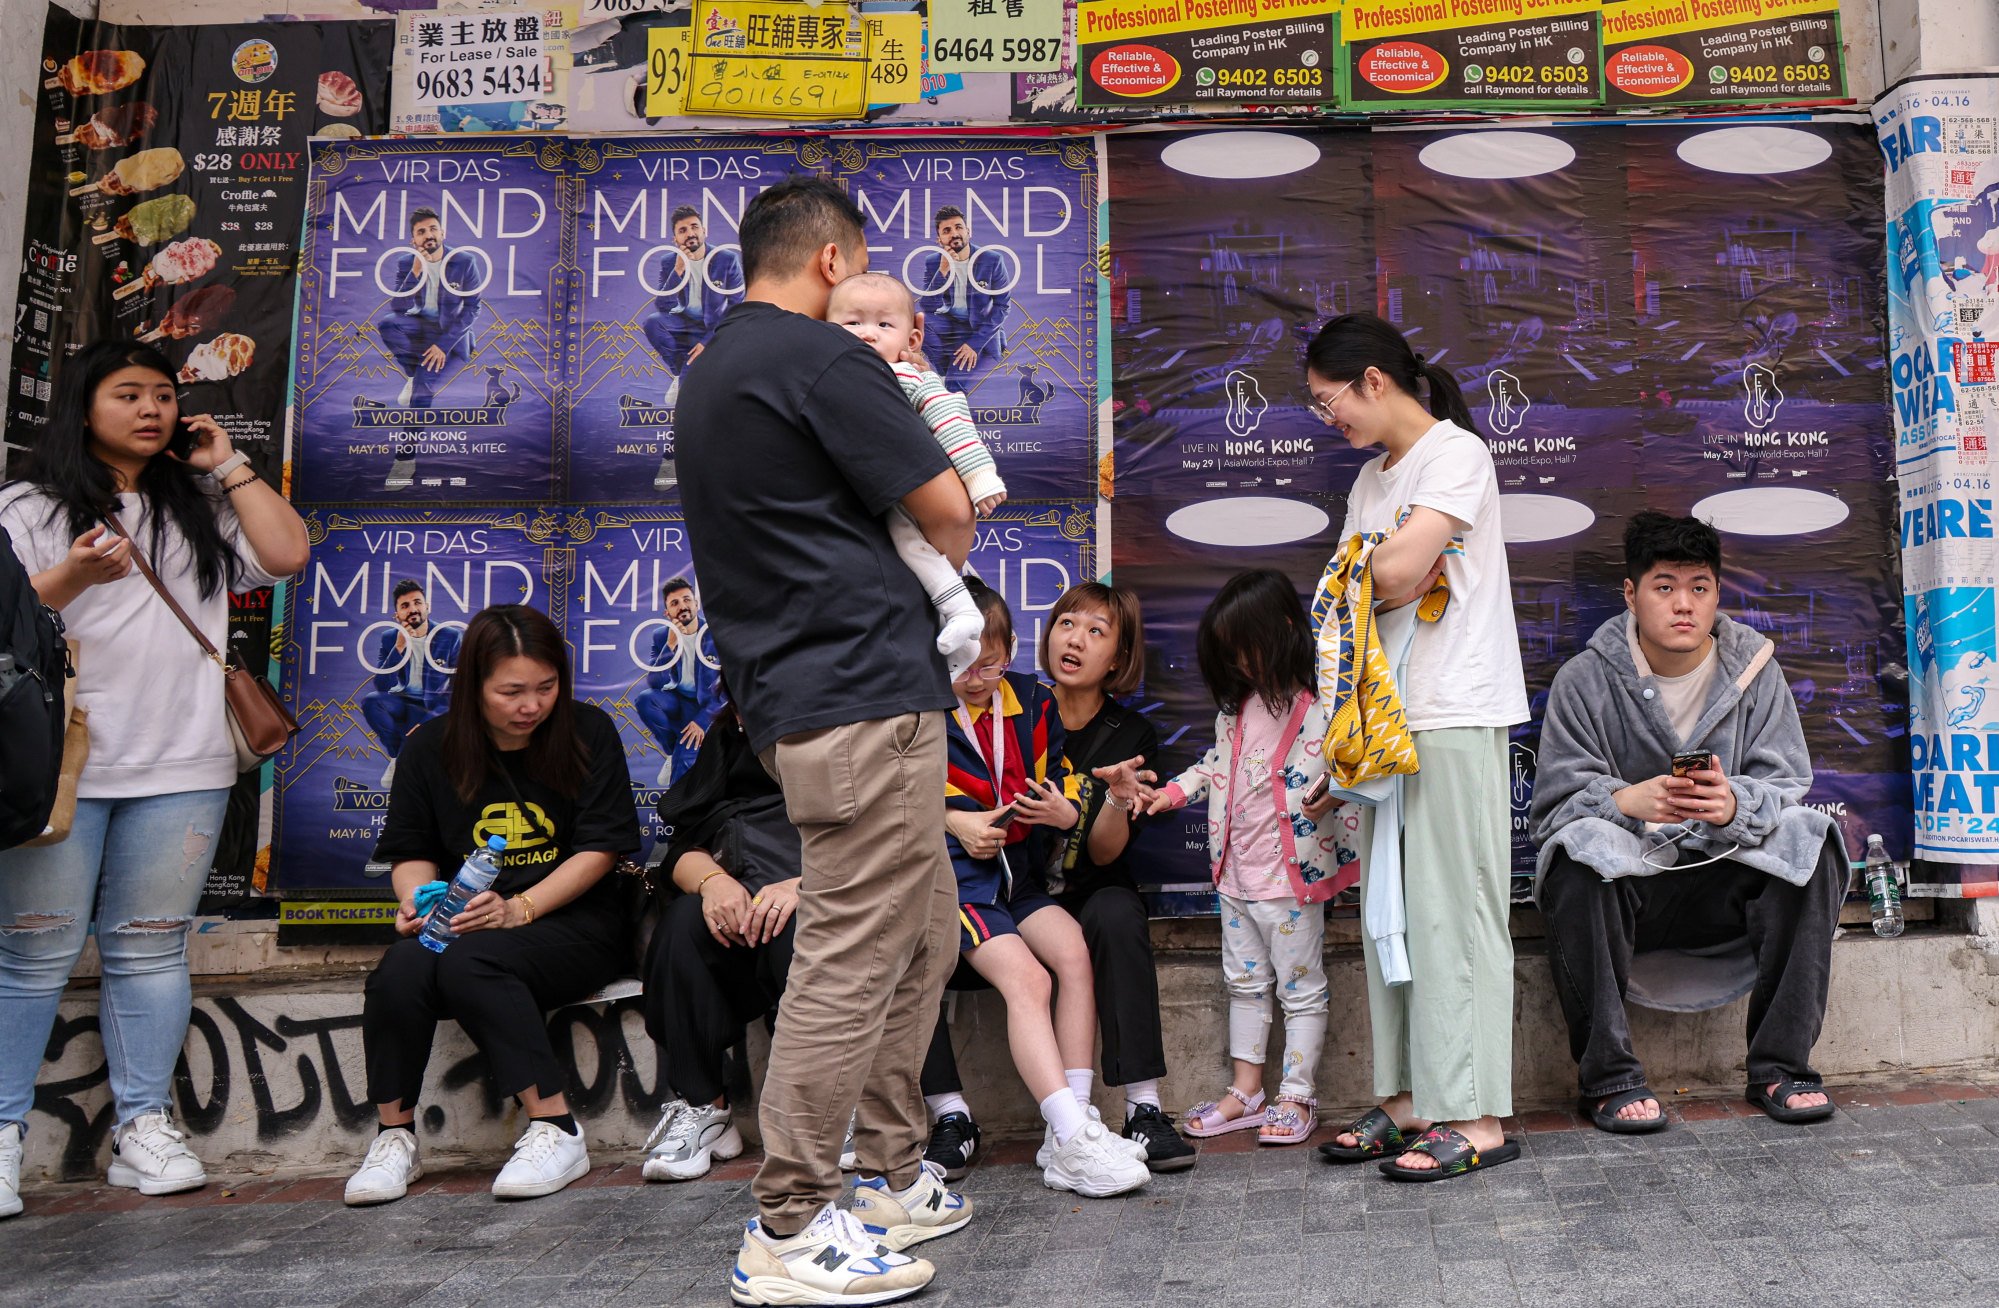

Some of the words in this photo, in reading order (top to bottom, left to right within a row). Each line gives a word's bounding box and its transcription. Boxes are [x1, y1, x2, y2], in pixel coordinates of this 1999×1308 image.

[1087, 0, 1181, 32] Professional
[1185, 0, 1258, 20] Postering
[1354, 0, 1447, 30] Professional
[1452, 0, 1523, 18] Postering
[1691, 0, 1762, 20] Postering
[418, 15, 540, 48] 業主放盤
[747, 14, 846, 50] 旺舖專家
[1190, 34, 1240, 48] Leading
[1243, 28, 1282, 42] Poster
[1285, 21, 1325, 36] Billing
[1457, 31, 1506, 45] Leading
[1509, 26, 1548, 40] Poster
[1551, 20, 1589, 34] Billing
[1700, 32, 1747, 47] Leading
[1750, 26, 1788, 40] Poster
[1791, 19, 1828, 34] Billing
[420, 52, 446, 64] For
[450, 50, 492, 62] Lease
[506, 46, 538, 58] Sale
[934, 38, 994, 62] 6464
[1002, 38, 1062, 62] 5987
[1192, 44, 1250, 60] Company
[1253, 40, 1265, 52] in
[1268, 38, 1288, 50] HK
[1376, 48, 1423, 59] Reliable,
[1459, 42, 1515, 57] Company
[1519, 38, 1532, 50] in
[1534, 35, 1553, 48] HK
[1703, 42, 1759, 59] Company
[1761, 38, 1772, 50] in
[1775, 35, 1794, 48] HK
[1108, 51, 1156, 62] Reliable,
[1370, 60, 1419, 70] Effective
[1422, 60, 1430, 69] &
[1621, 52, 1668, 63] Reliable,
[870, 63, 908, 84] 489
[1102, 63, 1151, 73] Effective
[1153, 63, 1162, 73] &
[1218, 68, 1267, 86] 9402
[1273, 67, 1323, 85] 6503
[1370, 72, 1434, 82] Economical
[1485, 65, 1534, 84] 9402
[1540, 65, 1589, 83] 6503
[1616, 64, 1664, 74] Effective
[1666, 63, 1675, 73] &
[1730, 65, 1777, 83] 9402
[1783, 64, 1831, 82] 6503
[417, 68, 474, 100] 9683
[483, 64, 541, 96] 5434
[1101, 75, 1166, 86] Economical
[1617, 74, 1680, 86] Economical
[1195, 87, 1214, 97] call
[1216, 87, 1267, 99] Raymond
[1269, 87, 1284, 97] for
[1286, 87, 1322, 97] details
[1464, 85, 1482, 94] call
[1485, 84, 1535, 96] Raymond
[1536, 84, 1552, 94] for
[1554, 84, 1589, 94] details
[1710, 85, 1728, 95] call
[1730, 84, 1778, 96] Raymond
[1781, 84, 1796, 93] for
[1798, 83, 1831, 92] details
[207, 90, 297, 122] 7週年
[1932, 96, 1970, 107] 04.16
[216, 126, 282, 148] 感謝祭
[193, 152, 233, 172] $28
[240, 152, 300, 170] ONLY
[380, 160, 430, 182] VIR
[438, 158, 501, 182] DAS
[638, 158, 690, 181] VIR
[698, 156, 762, 180] DAS
[902, 158, 953, 182] VIR
[962, 156, 1026, 181] DAS
[220, 190, 259, 200] Croffle
[332, 188, 546, 241] MIND
[594, 186, 773, 240] MIN
[857, 186, 1072, 239] MIND
[254, 222, 274, 230] $28
[328, 245, 542, 298] FOOL
[592, 244, 746, 298] FOO
[370, 410, 437, 426] WORLD
[440, 410, 488, 424] TOUR
[974, 409, 1022, 423] TOUR
[388, 432, 428, 442] HONG
[430, 431, 467, 441] KONG
[1488, 438, 1528, 454] HONG
[1534, 436, 1576, 453] KONG
[1703, 435, 1724, 445] LIVE
[1727, 434, 1738, 444] IN
[1744, 431, 1781, 446] HONG
[1788, 430, 1829, 446] KONG
[348, 445, 376, 456] MAY
[378, 444, 390, 454] 16
[395, 444, 457, 454] ROTUNDA
[472, 442, 506, 454] KITEC
[616, 444, 644, 454] MAY
[646, 444, 658, 454] 16
[1007, 442, 1042, 452] KITEC
[1182, 444, 1204, 454] LIVE
[1208, 444, 1219, 452] IN
[1225, 440, 1264, 456] HONG
[1271, 438, 1314, 455] KONG
[1703, 451, 1722, 460] May
[1722, 450, 1734, 459] 29
[1807, 450, 1823, 458] Hall
[1182, 460, 1201, 470] May
[1202, 460, 1214, 468] 29
[1224, 458, 1290, 468] AsiaWorld-Expo,
[1292, 457, 1308, 466] Hall
[1309, 457, 1314, 465] 7
[1555, 455, 1570, 464] Hall
[1572, 455, 1577, 463] 7
[1954, 478, 1990, 490] 04.16
[363, 530, 416, 554] VIR
[424, 530, 488, 554] DAS
[632, 528, 684, 552] VIR
[312, 560, 534, 614] MIND
[329, 829, 358, 839] MAY
[360, 828, 372, 838] 16
[1185, 824, 1208, 834] LIVE
[1185, 841, 1205, 851] May
[285, 910, 326, 921] BOOK
[327, 909, 384, 920] TICKETS
